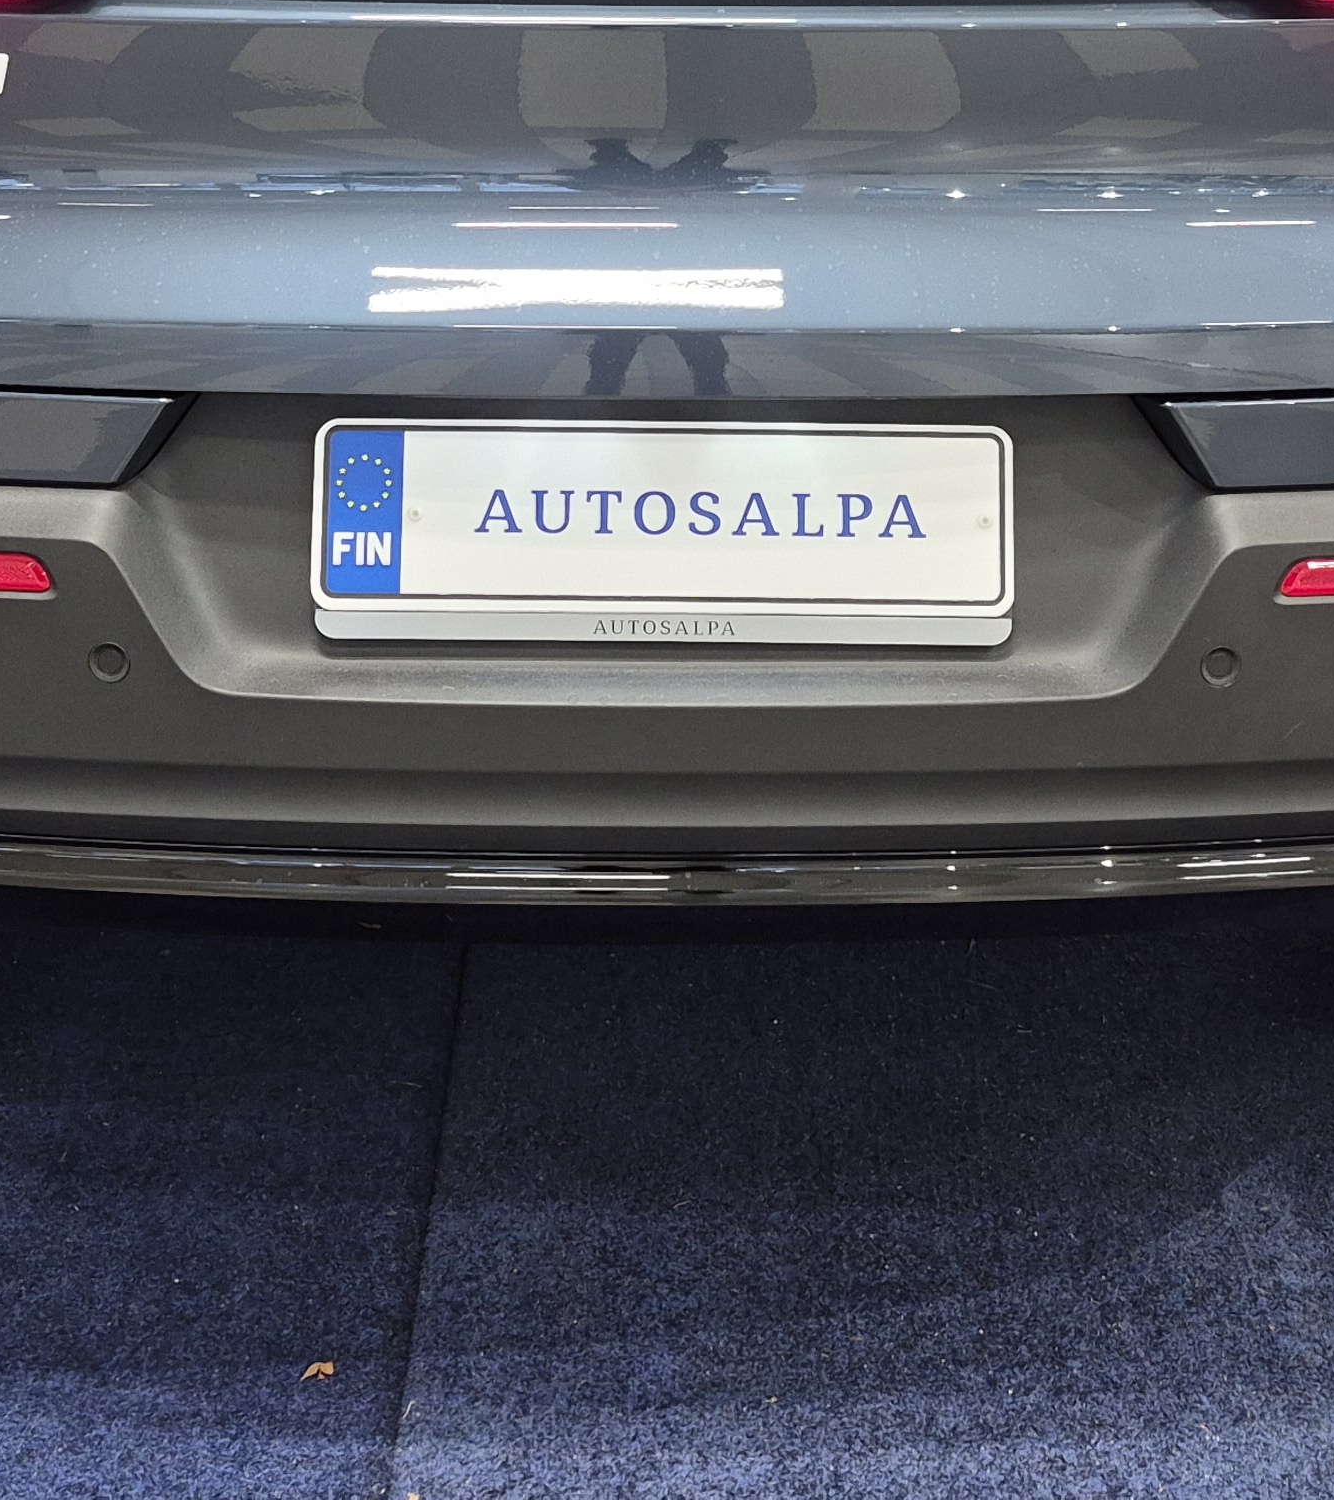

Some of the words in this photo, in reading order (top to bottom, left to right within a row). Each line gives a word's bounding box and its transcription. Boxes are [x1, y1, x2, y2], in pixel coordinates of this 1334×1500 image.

[474, 488, 927, 539] AUTOSALPA
[332, 531, 392, 566] FIN
[592, 619, 736, 636] AUTOSALPA
